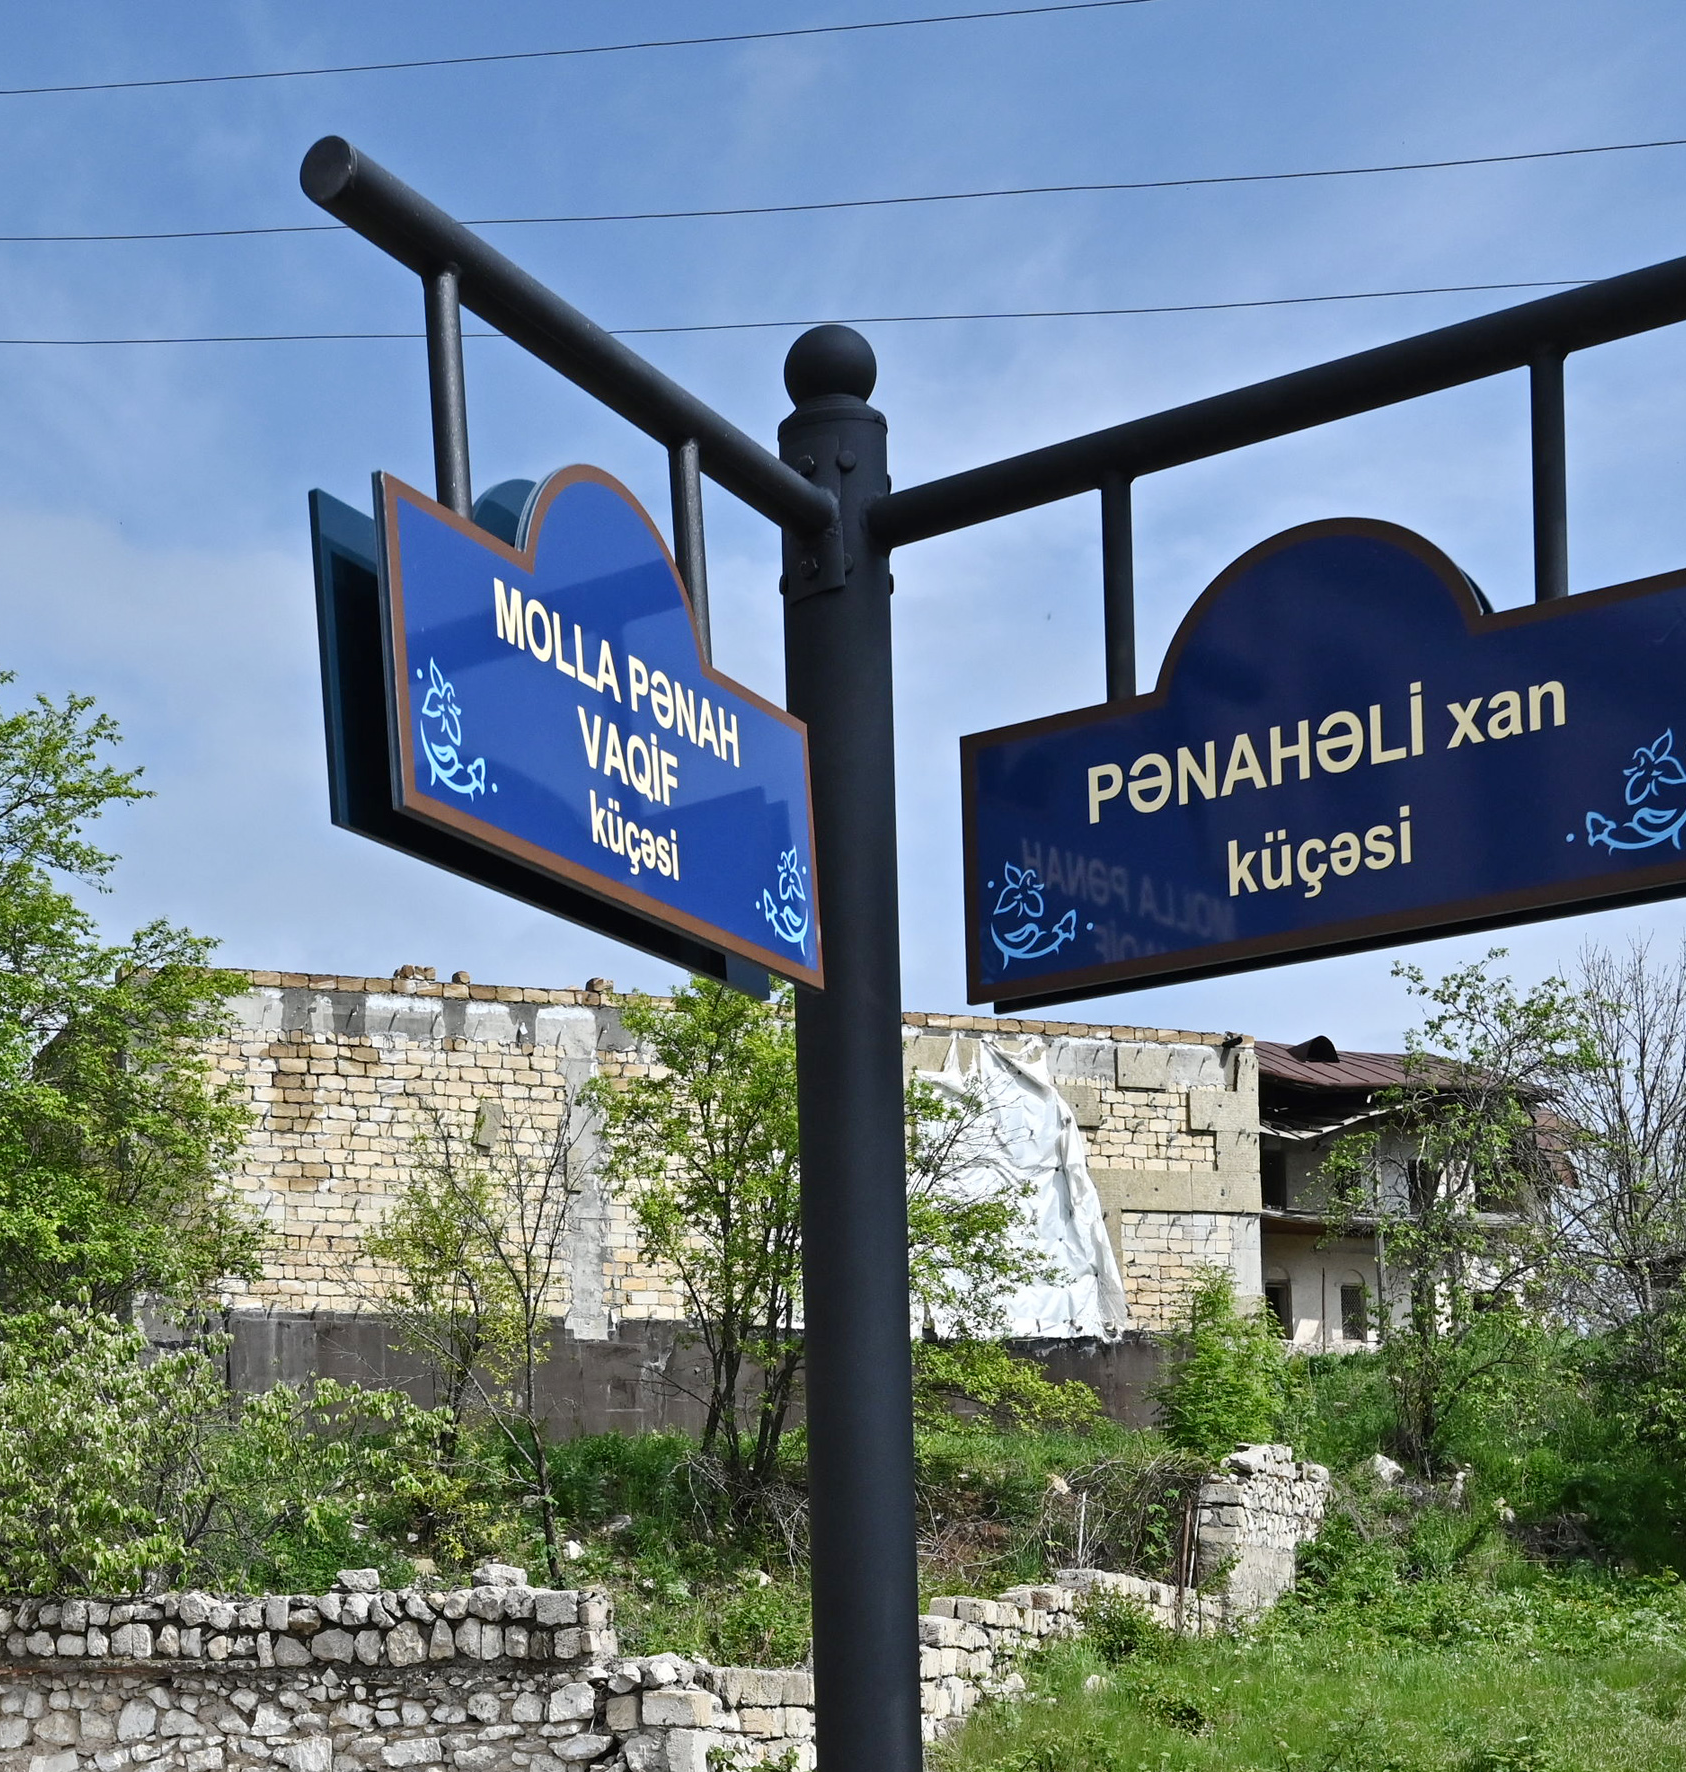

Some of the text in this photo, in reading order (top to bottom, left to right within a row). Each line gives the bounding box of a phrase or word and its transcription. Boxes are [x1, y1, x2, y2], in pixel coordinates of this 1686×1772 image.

[493, 577, 741, 768] MOLLA PƏNAH
[576, 705, 678, 809] VAQİF
[1086, 679, 1567, 825] PƏNAHƏLİ xan
[589, 789, 680, 881] küçəsi
[1226, 804, 1413, 898] küçəsi
